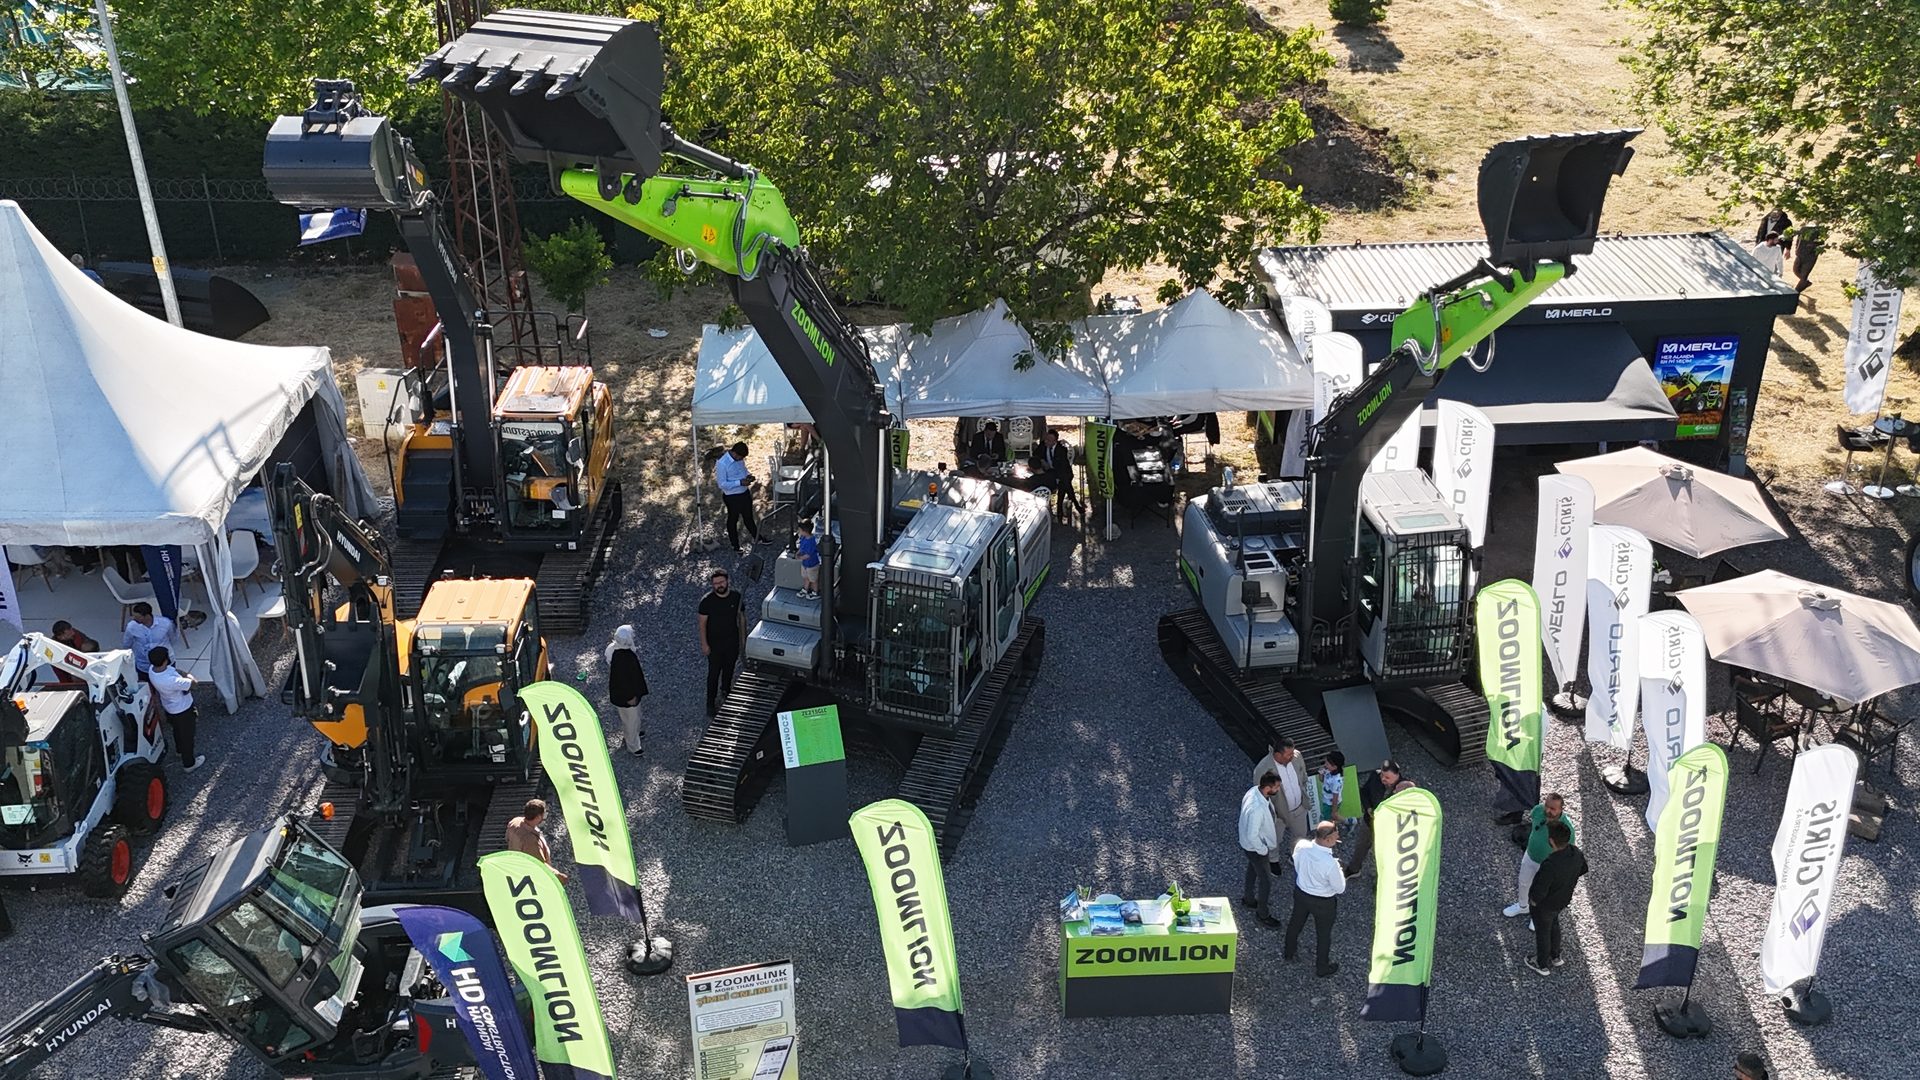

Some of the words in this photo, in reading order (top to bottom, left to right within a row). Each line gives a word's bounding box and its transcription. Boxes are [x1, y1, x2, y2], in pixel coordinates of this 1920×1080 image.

[1561, 308, 1612, 317] MERLO
[791, 299, 835, 367] ZOOMLION
[1679, 342, 1733, 351] MERLO
[1356, 381, 1393, 427] ZOOMLION
[892, 434, 902, 467] LION
[160, 550, 170, 562] HD
[336, 530, 361, 563] HYUNDAI
[781, 714, 793, 763] ZOOMLION
[1075, 944, 1229, 965] ZOOMLION
[714, 968, 787, 988] ZOOMLINK
[45, 998, 112, 1052] HYUNDAI
